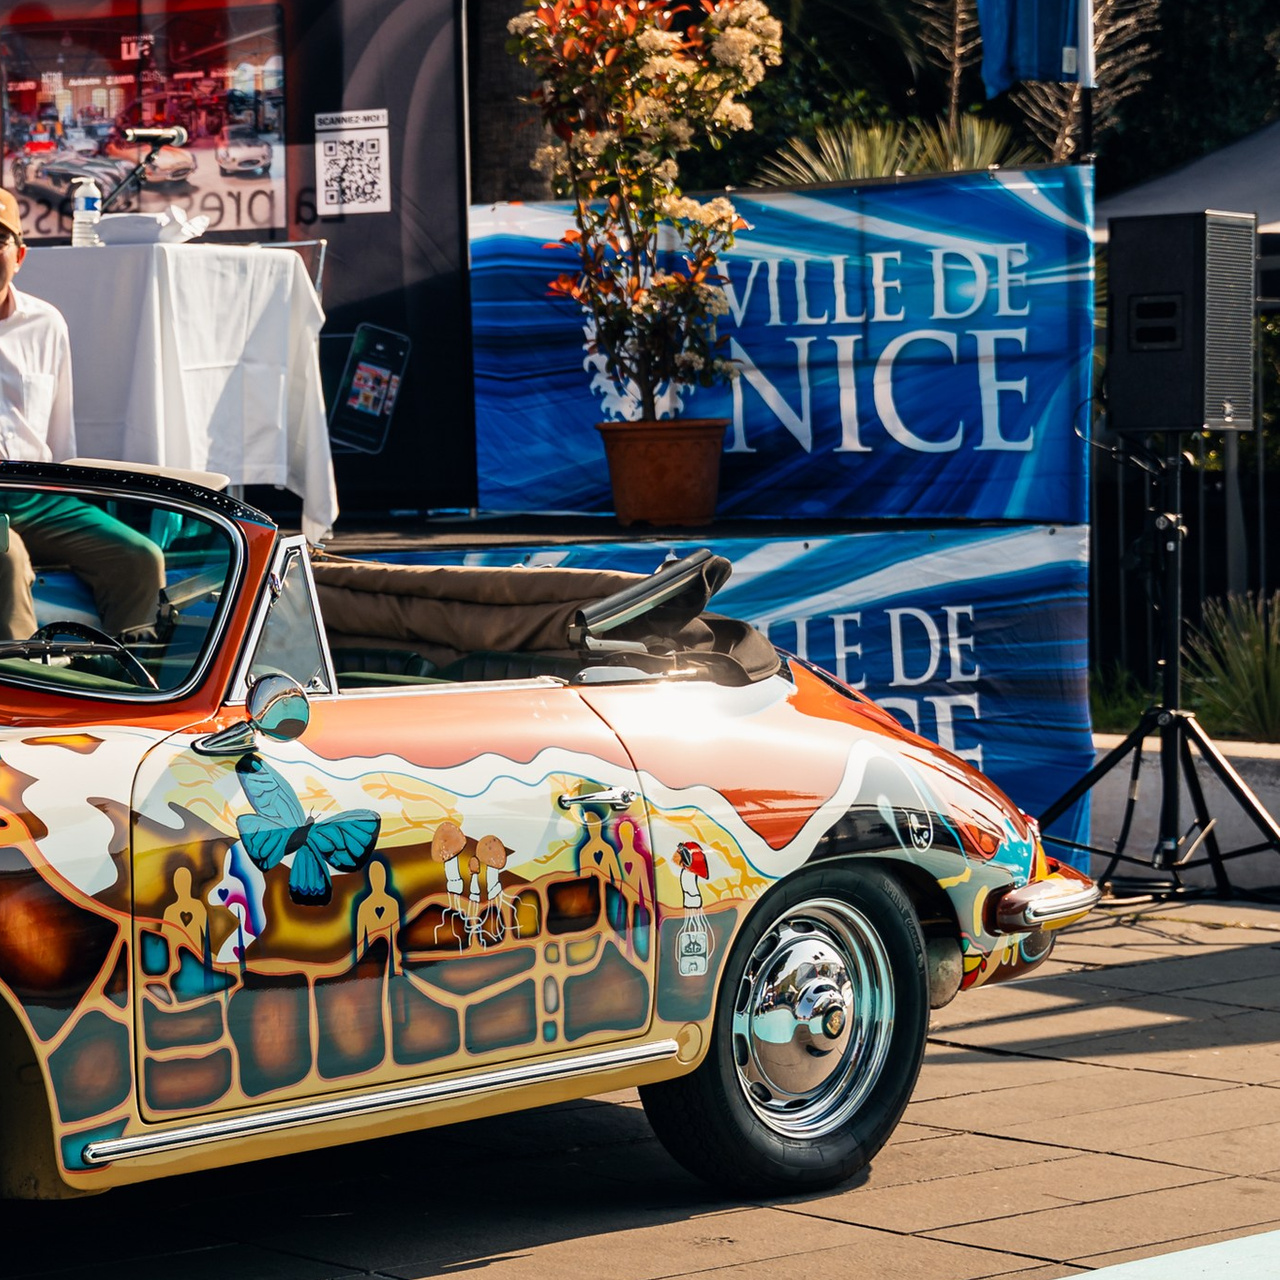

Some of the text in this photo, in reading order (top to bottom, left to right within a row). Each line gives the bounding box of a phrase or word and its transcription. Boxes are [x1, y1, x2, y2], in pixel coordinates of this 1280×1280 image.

[715, 242, 1030, 328] VILLE DE
[724, 327, 1034, 454] NICE
[883, 604, 981, 687] DE
